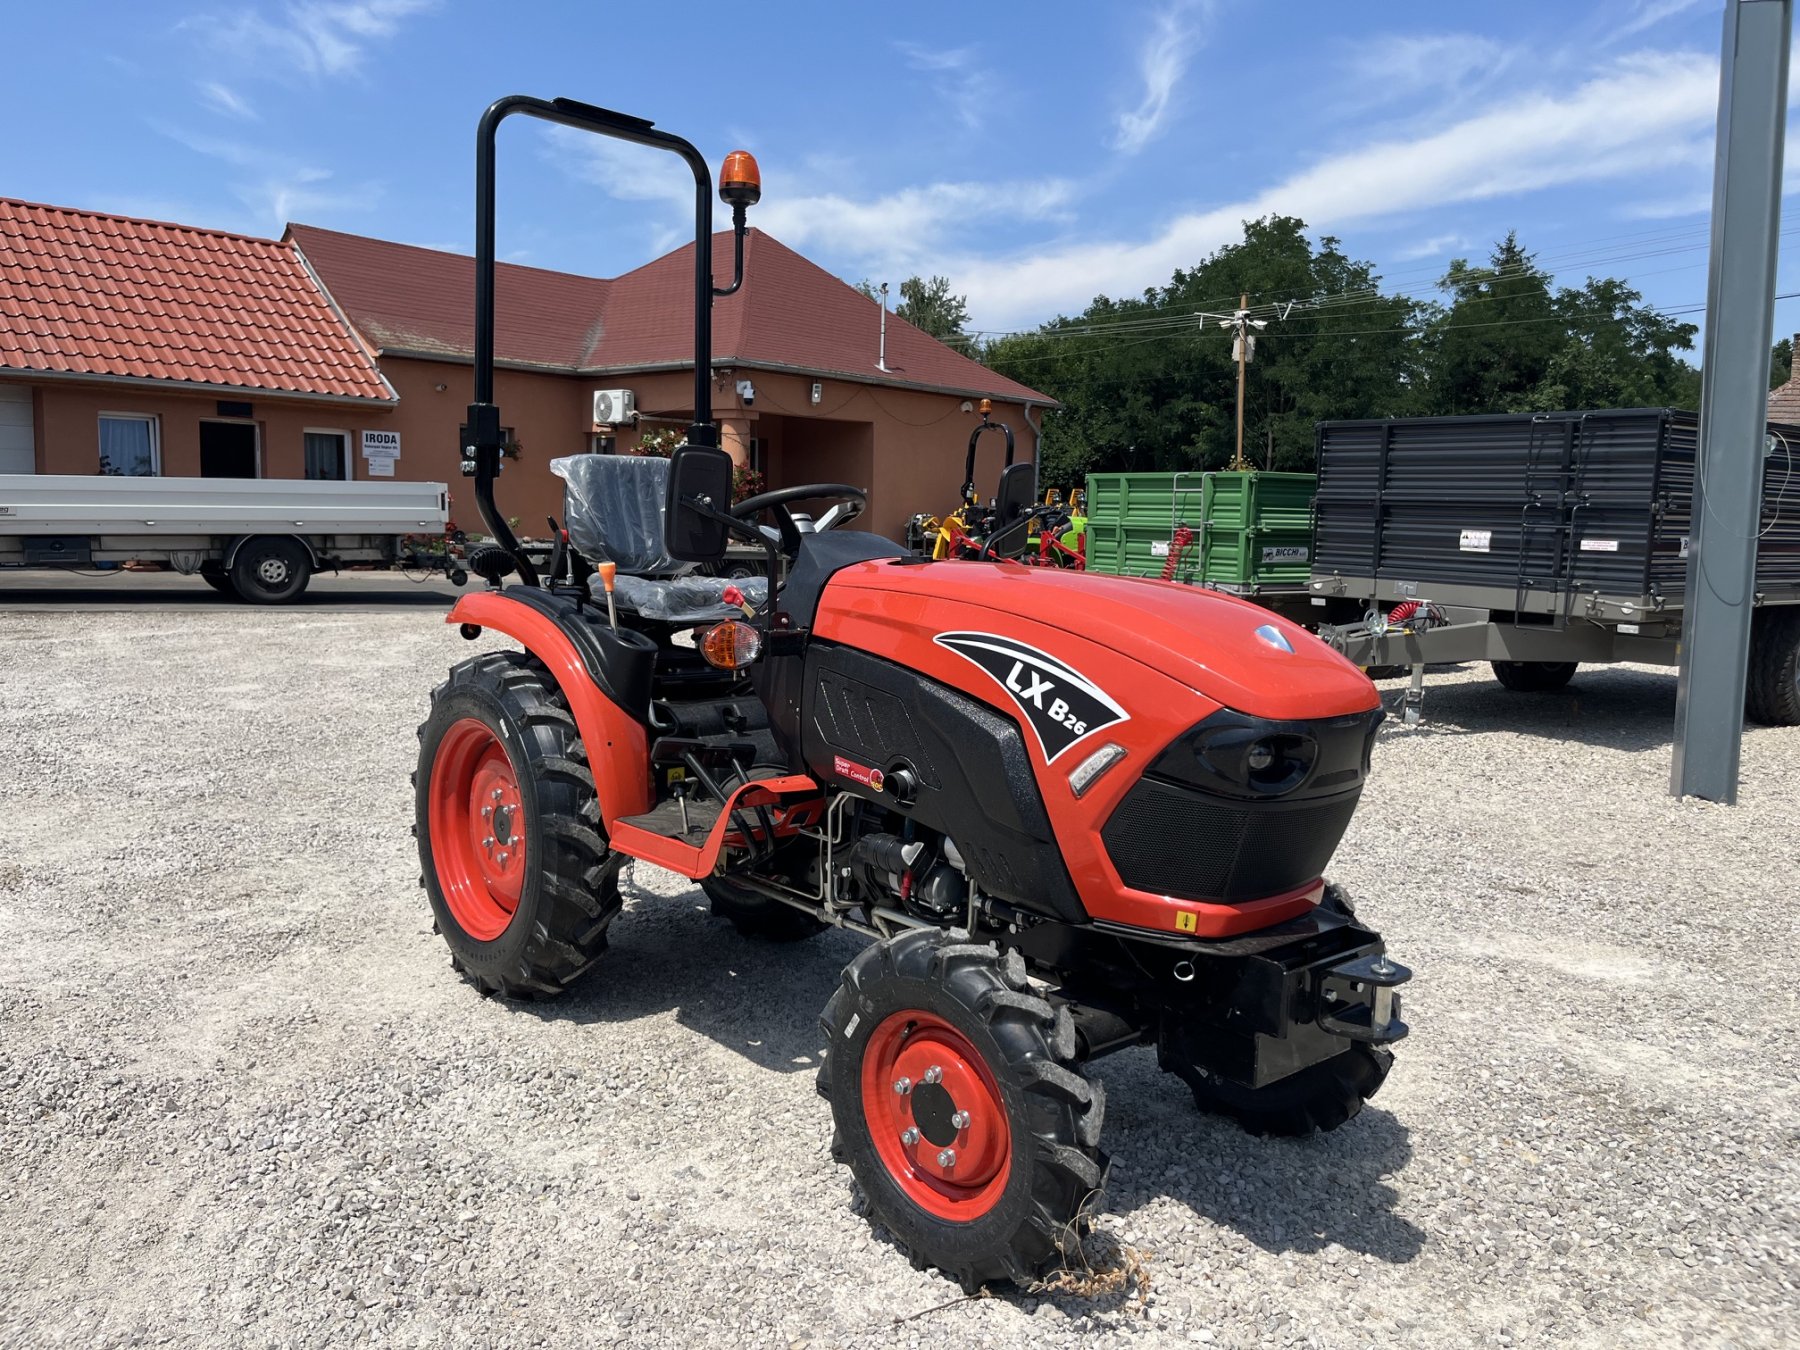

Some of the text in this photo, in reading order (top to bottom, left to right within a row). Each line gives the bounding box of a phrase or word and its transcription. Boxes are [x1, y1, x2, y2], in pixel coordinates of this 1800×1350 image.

[365, 432, 397, 445] IRODA
[1275, 548, 1300, 557] BICCHI
[1005, 660, 1056, 710] LX
[835, 757, 851, 769] Super
[850, 770, 870, 783] Control
